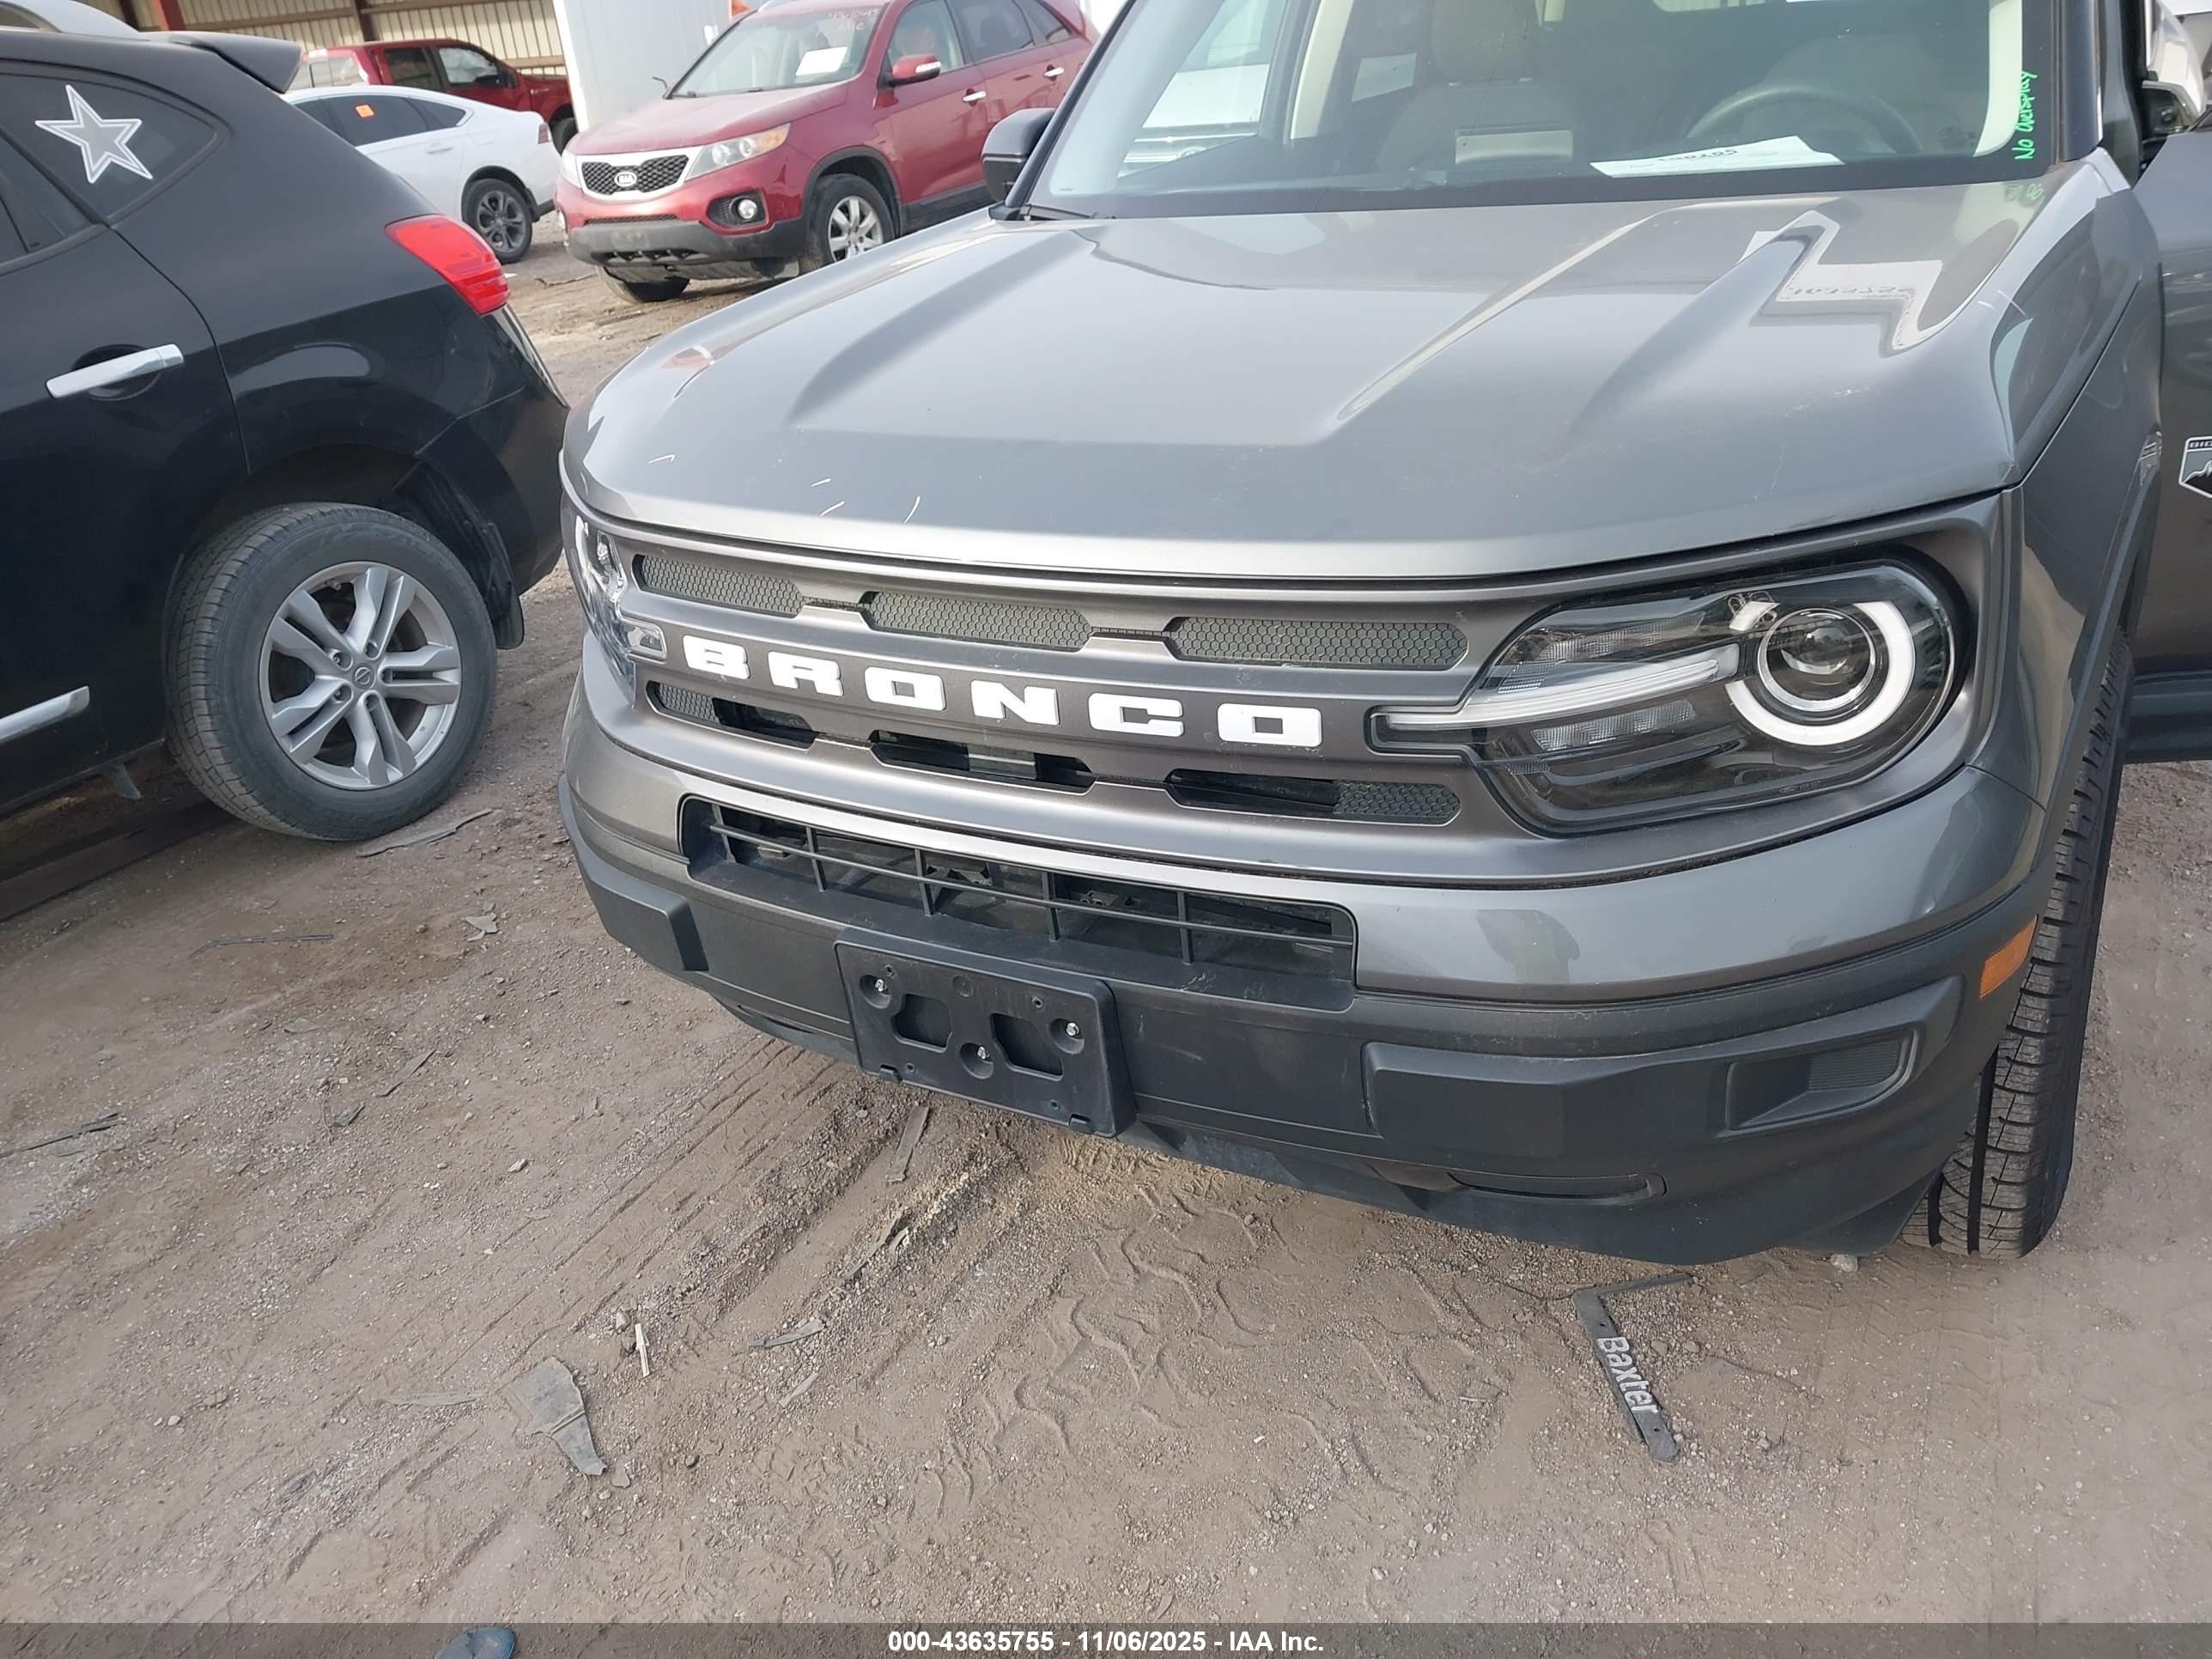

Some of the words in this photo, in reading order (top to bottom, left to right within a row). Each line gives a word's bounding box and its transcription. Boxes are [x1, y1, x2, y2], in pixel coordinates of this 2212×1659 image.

[2011, 138, 2036, 160] No
[683, 634, 1322, 747] BRONCO
[1595, 1336, 1659, 1414] Baxter
